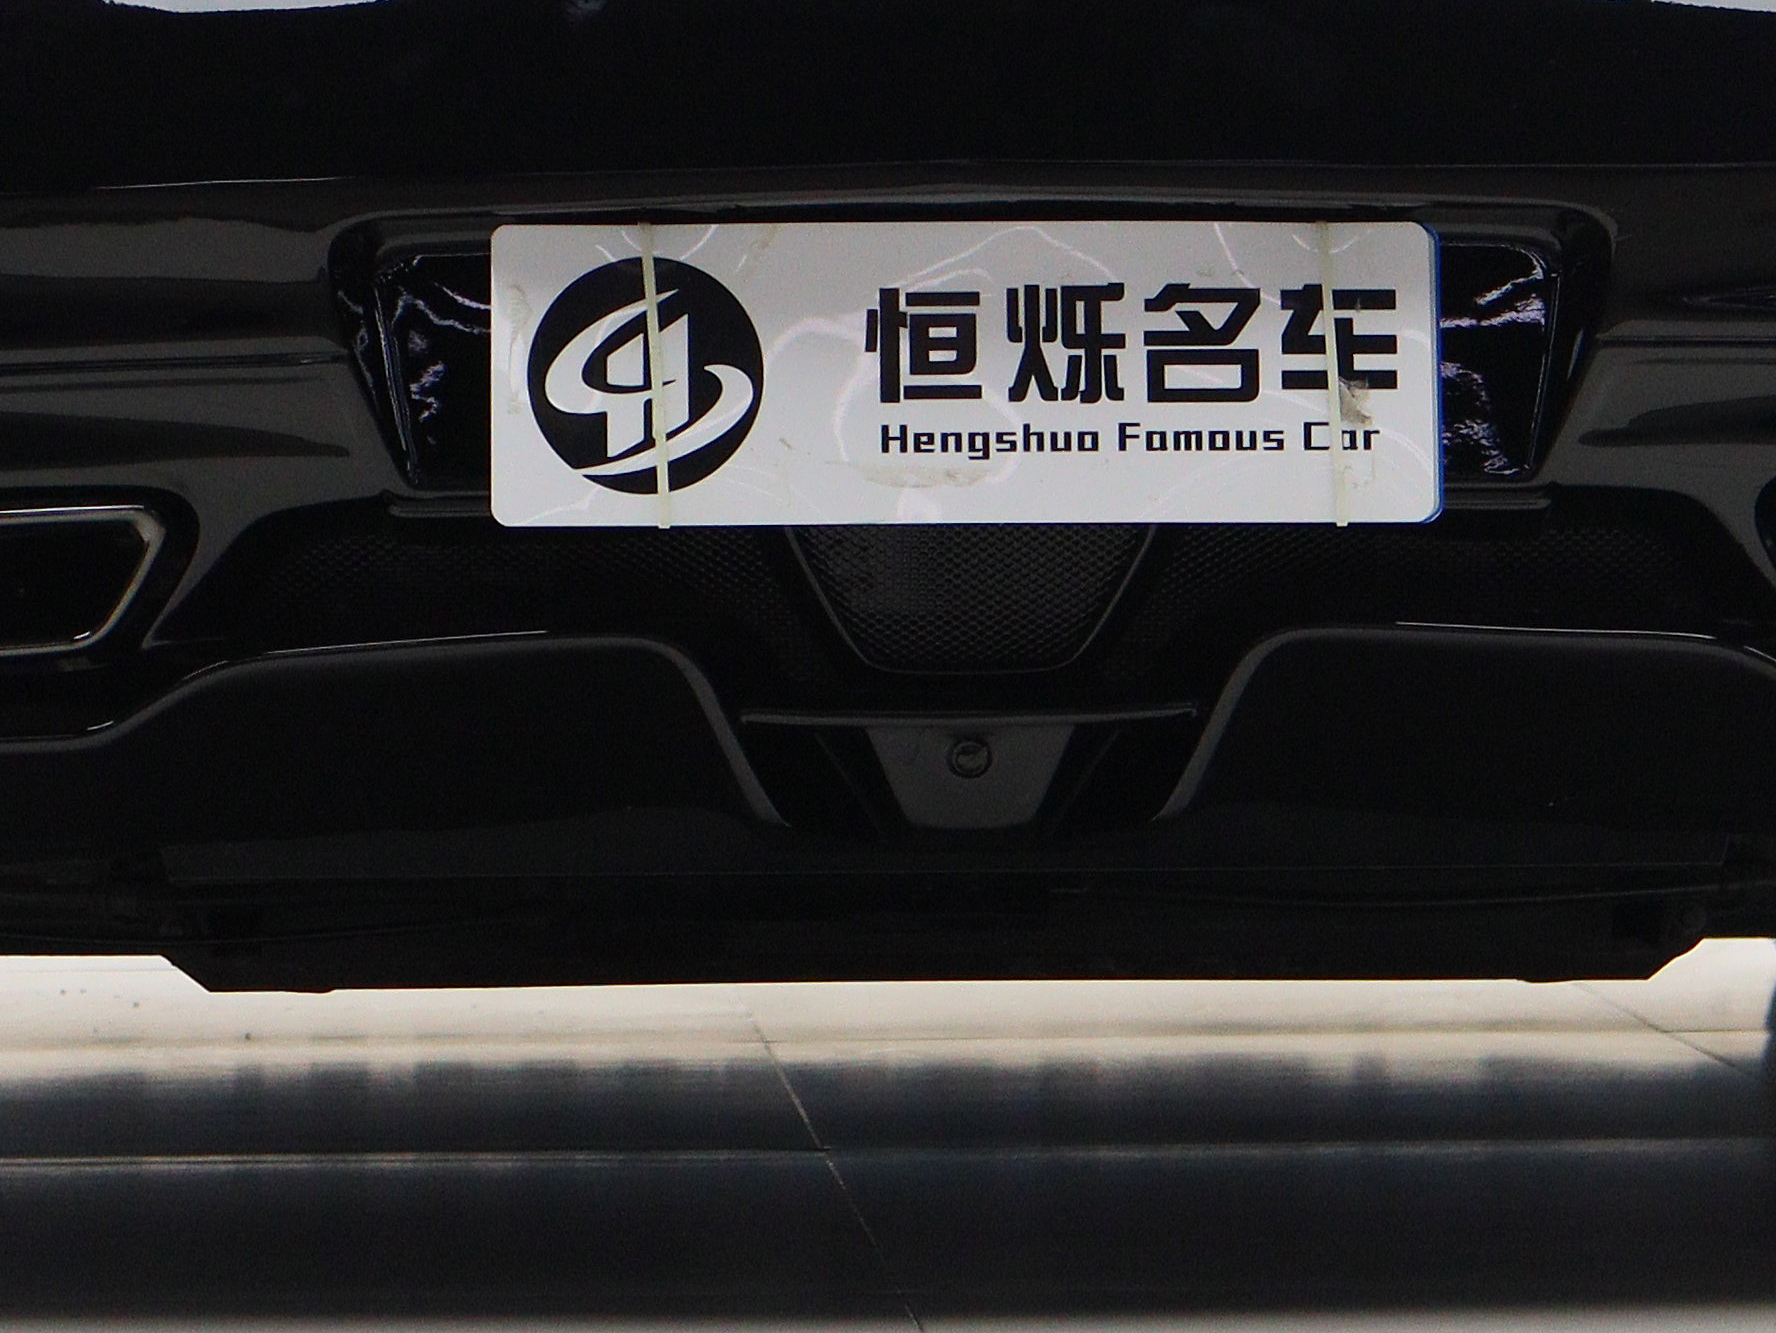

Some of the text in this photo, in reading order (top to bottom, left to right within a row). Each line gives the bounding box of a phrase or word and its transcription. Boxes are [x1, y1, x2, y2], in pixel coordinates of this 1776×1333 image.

[865, 282, 1398, 404] 恒烁名车
[880, 421, 1380, 460] Hengshuo Famous Car
